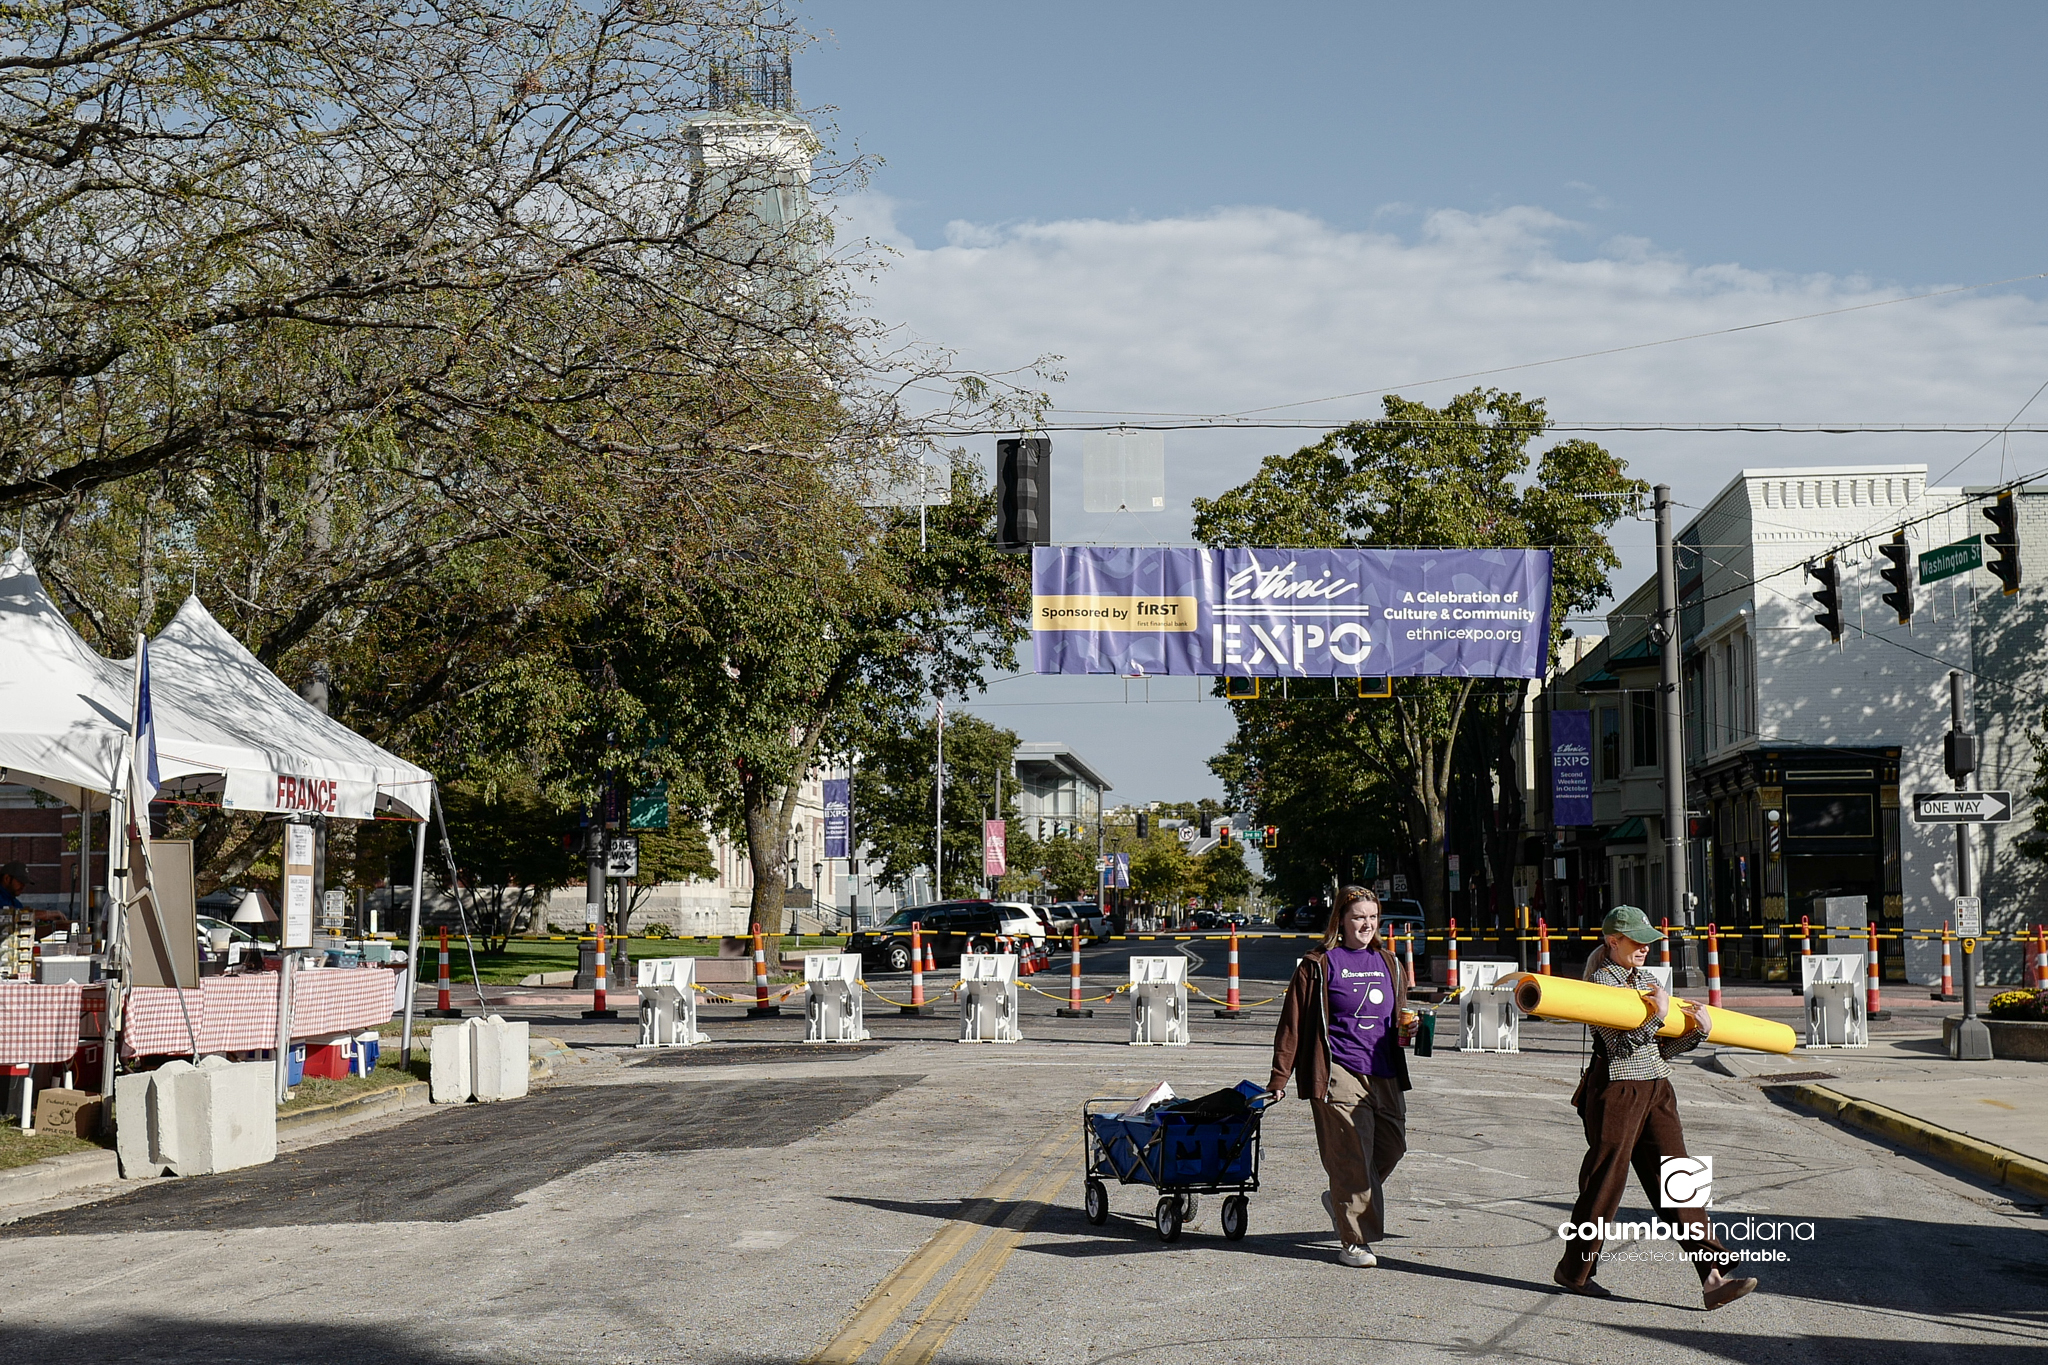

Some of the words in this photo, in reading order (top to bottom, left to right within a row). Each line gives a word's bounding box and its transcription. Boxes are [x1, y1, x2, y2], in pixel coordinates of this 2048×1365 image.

[1920, 549, 1969, 577] Washington
[1971, 543, 1981, 561] St
[1226, 561, 1359, 600] Ethnic
[1402, 592, 1415, 603] A
[1416, 591, 1501, 604] Celebration
[1503, 591, 1519, 604] of
[1041, 607, 1109, 619] Sponsored
[1112, 608, 1129, 620] by
[1383, 608, 1438, 620] Culture
[1440, 608, 1450, 621] &
[1452, 608, 1536, 622] Community
[1406, 627, 1523, 644] ethnicexpo.org
[1212, 622, 1372, 665] EXPO
[1557, 743, 1586, 752] Ethnic
[1554, 756, 1589, 766] EXPO
[276, 774, 337, 813] FRANCE
[825, 810, 849, 818] EXPO
[1923, 801, 1950, 814] ONE
[1954, 801, 1981, 814] WAY
[612, 841, 632, 850] ONE
[611, 850, 632, 861] WAY
